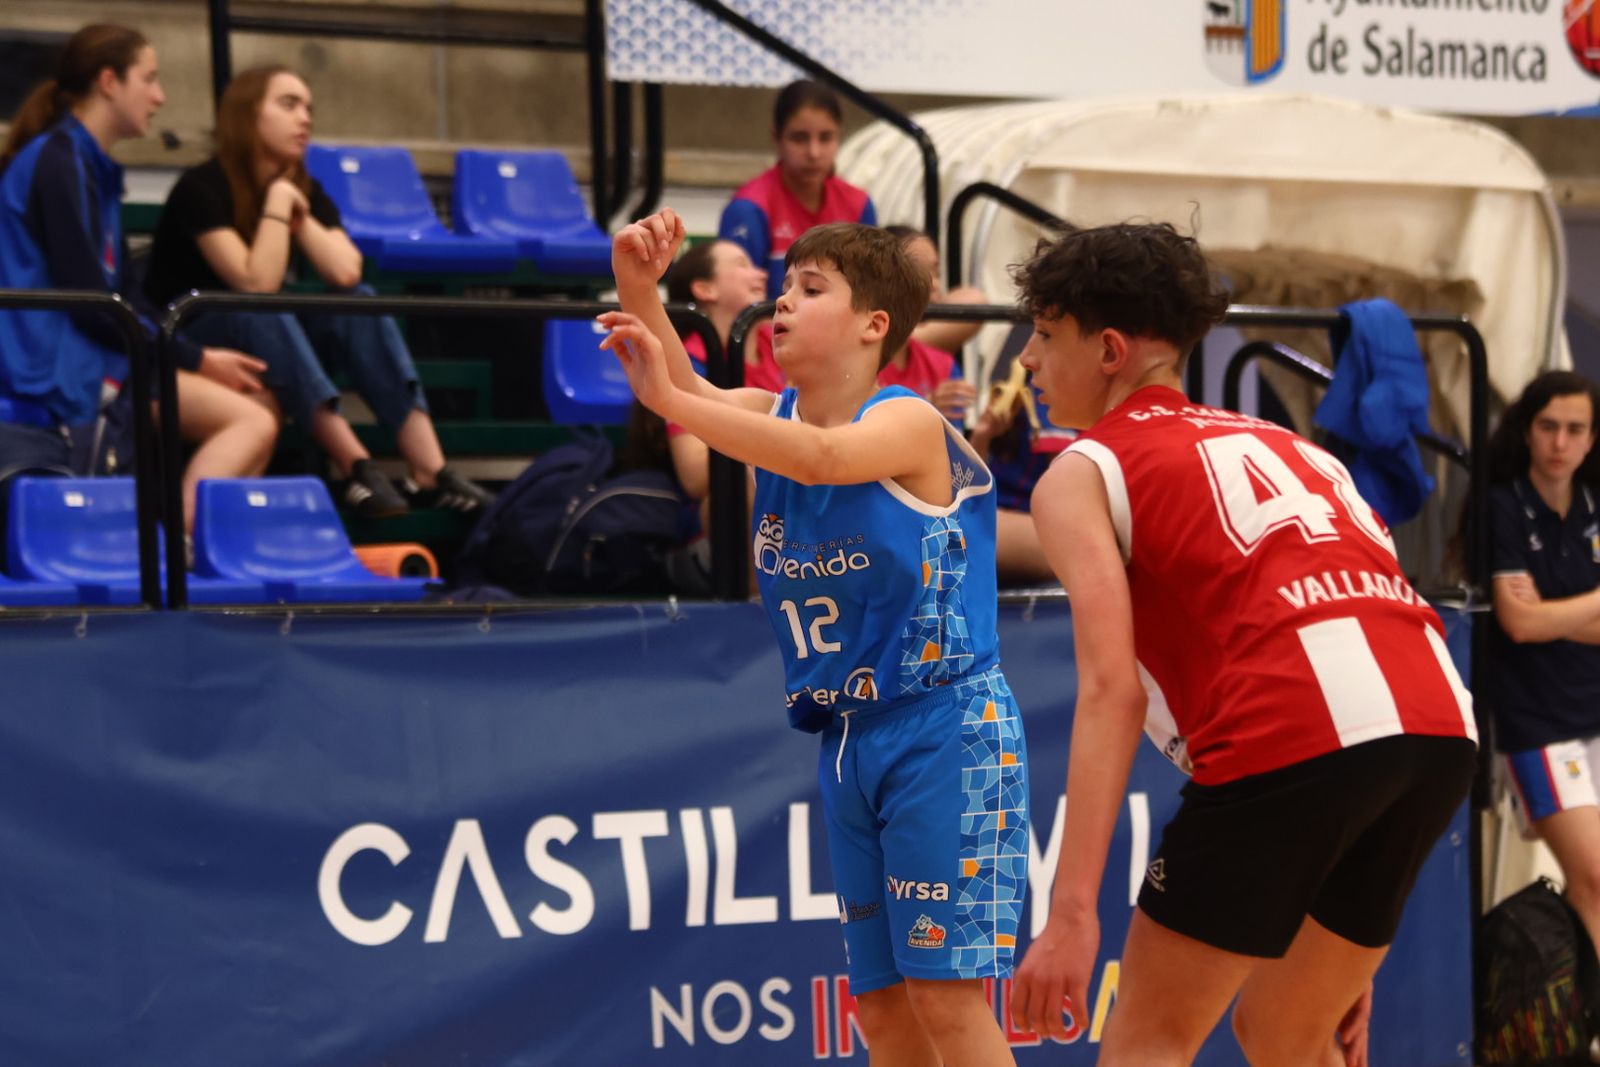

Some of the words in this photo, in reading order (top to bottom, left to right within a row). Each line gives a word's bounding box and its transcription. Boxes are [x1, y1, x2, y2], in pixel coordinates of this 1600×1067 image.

[1307, 22, 1348, 74] de
[1362, 22, 1547, 82] Salamanca
[779, 596, 841, 660] 12
[318, 803, 841, 946] CASTILL
[651, 977, 795, 1048] NOS
